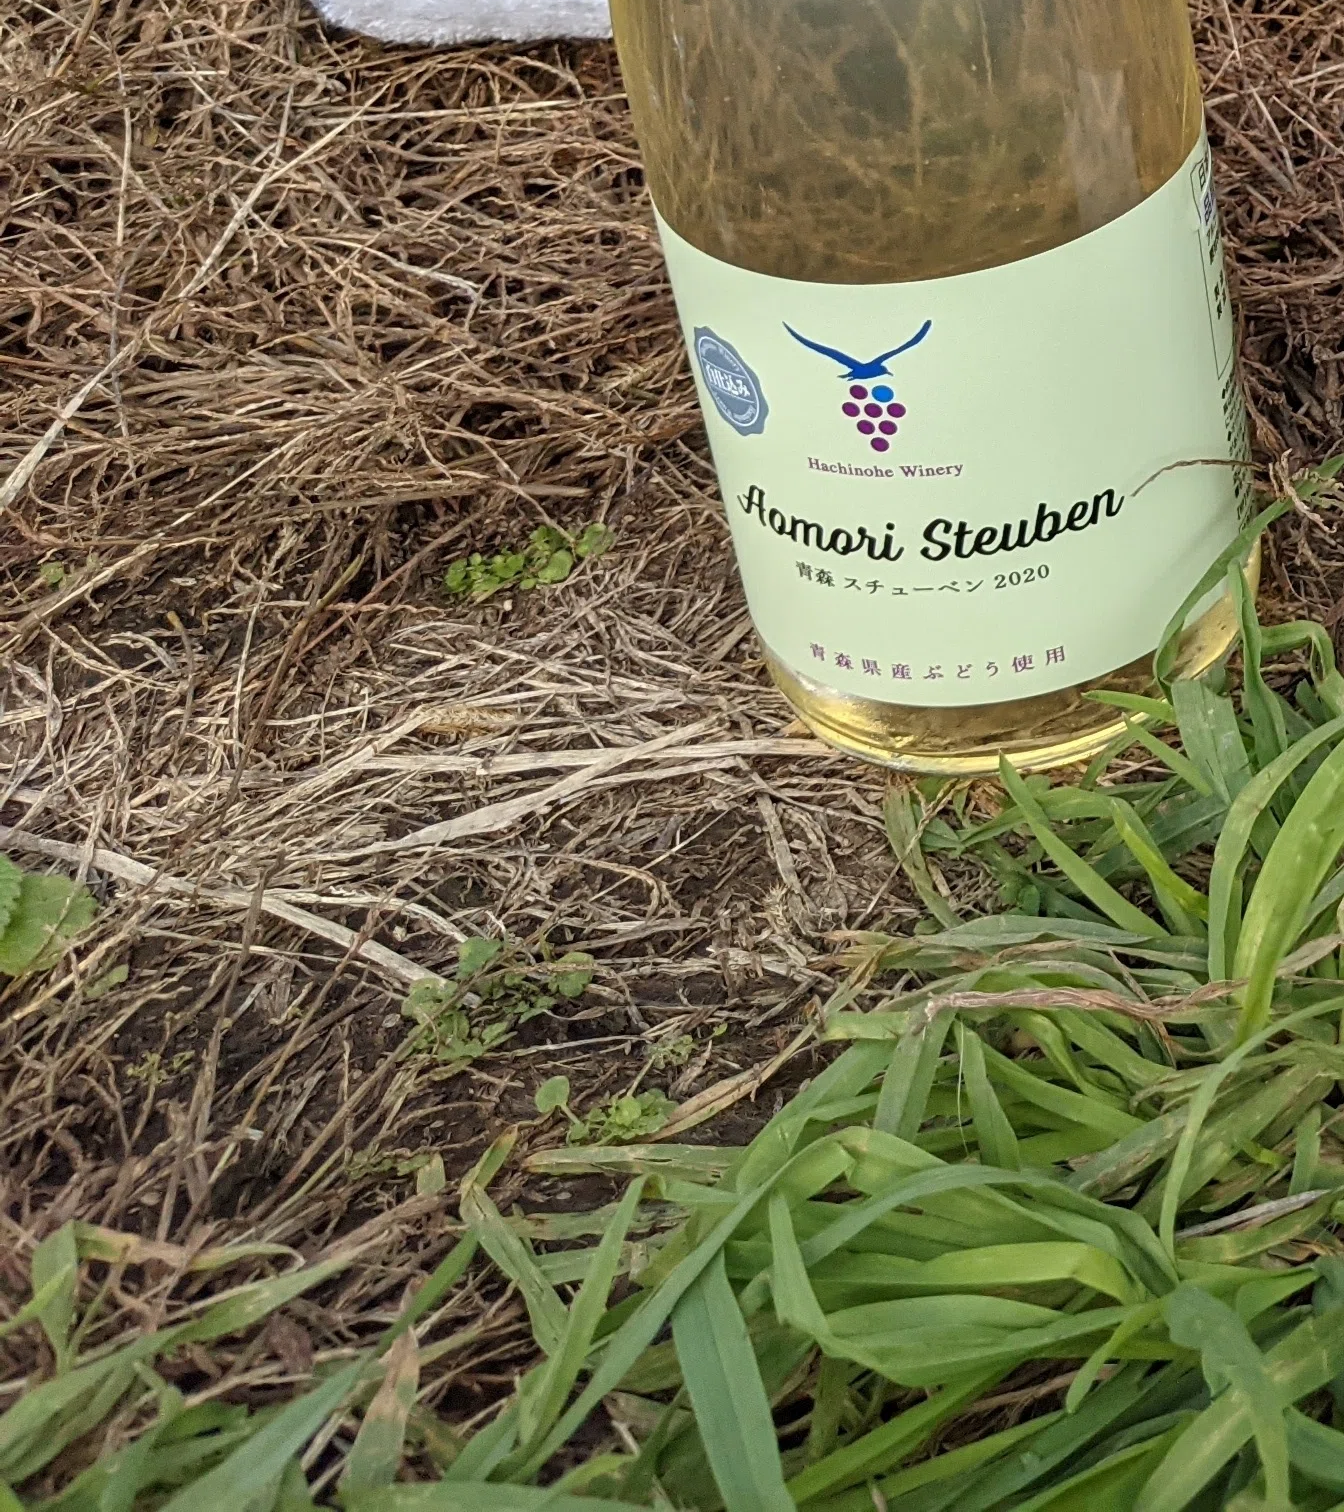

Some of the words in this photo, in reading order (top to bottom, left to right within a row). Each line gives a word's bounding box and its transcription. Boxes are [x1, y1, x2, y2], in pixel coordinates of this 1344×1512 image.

[807, 457, 895, 479] Hachinohe
[899, 463, 964, 478] Winery
[736, 484, 904, 562] Aomori
[920, 487, 1124, 562] Steuben
[795, 561, 836, 588] 青森
[843, 577, 985, 595] スチューベン
[994, 564, 1050, 590] 2020
[810, 643, 1066, 680] 青森県産ぶどう使用
